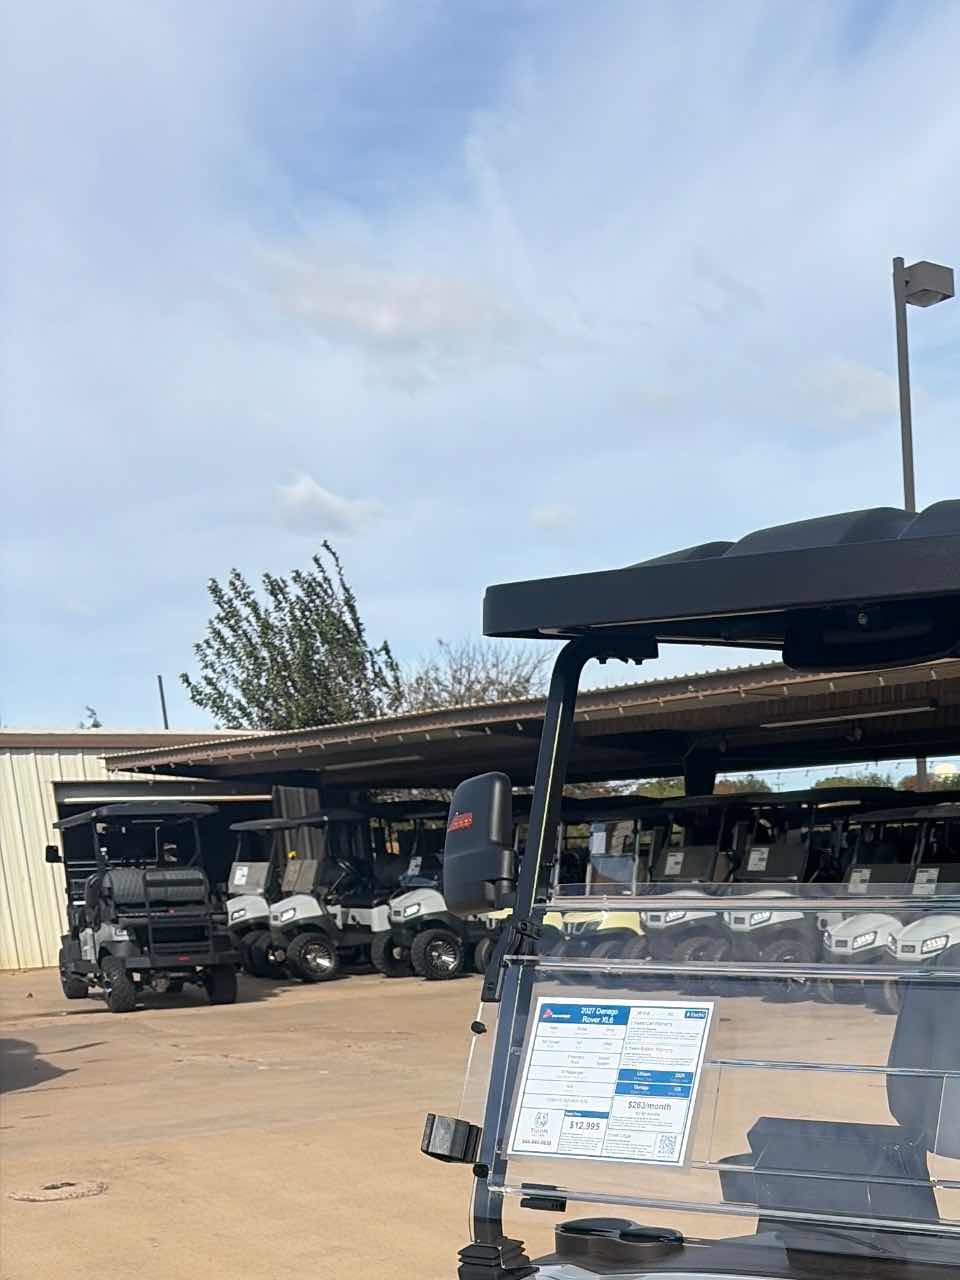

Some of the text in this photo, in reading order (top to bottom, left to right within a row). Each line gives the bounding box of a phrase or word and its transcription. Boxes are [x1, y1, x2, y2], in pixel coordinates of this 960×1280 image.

[596, 1007, 618, 1017] Denago
[582, 1015, 601, 1023] Rover
[569, 1120, 600, 1131] $12,995
